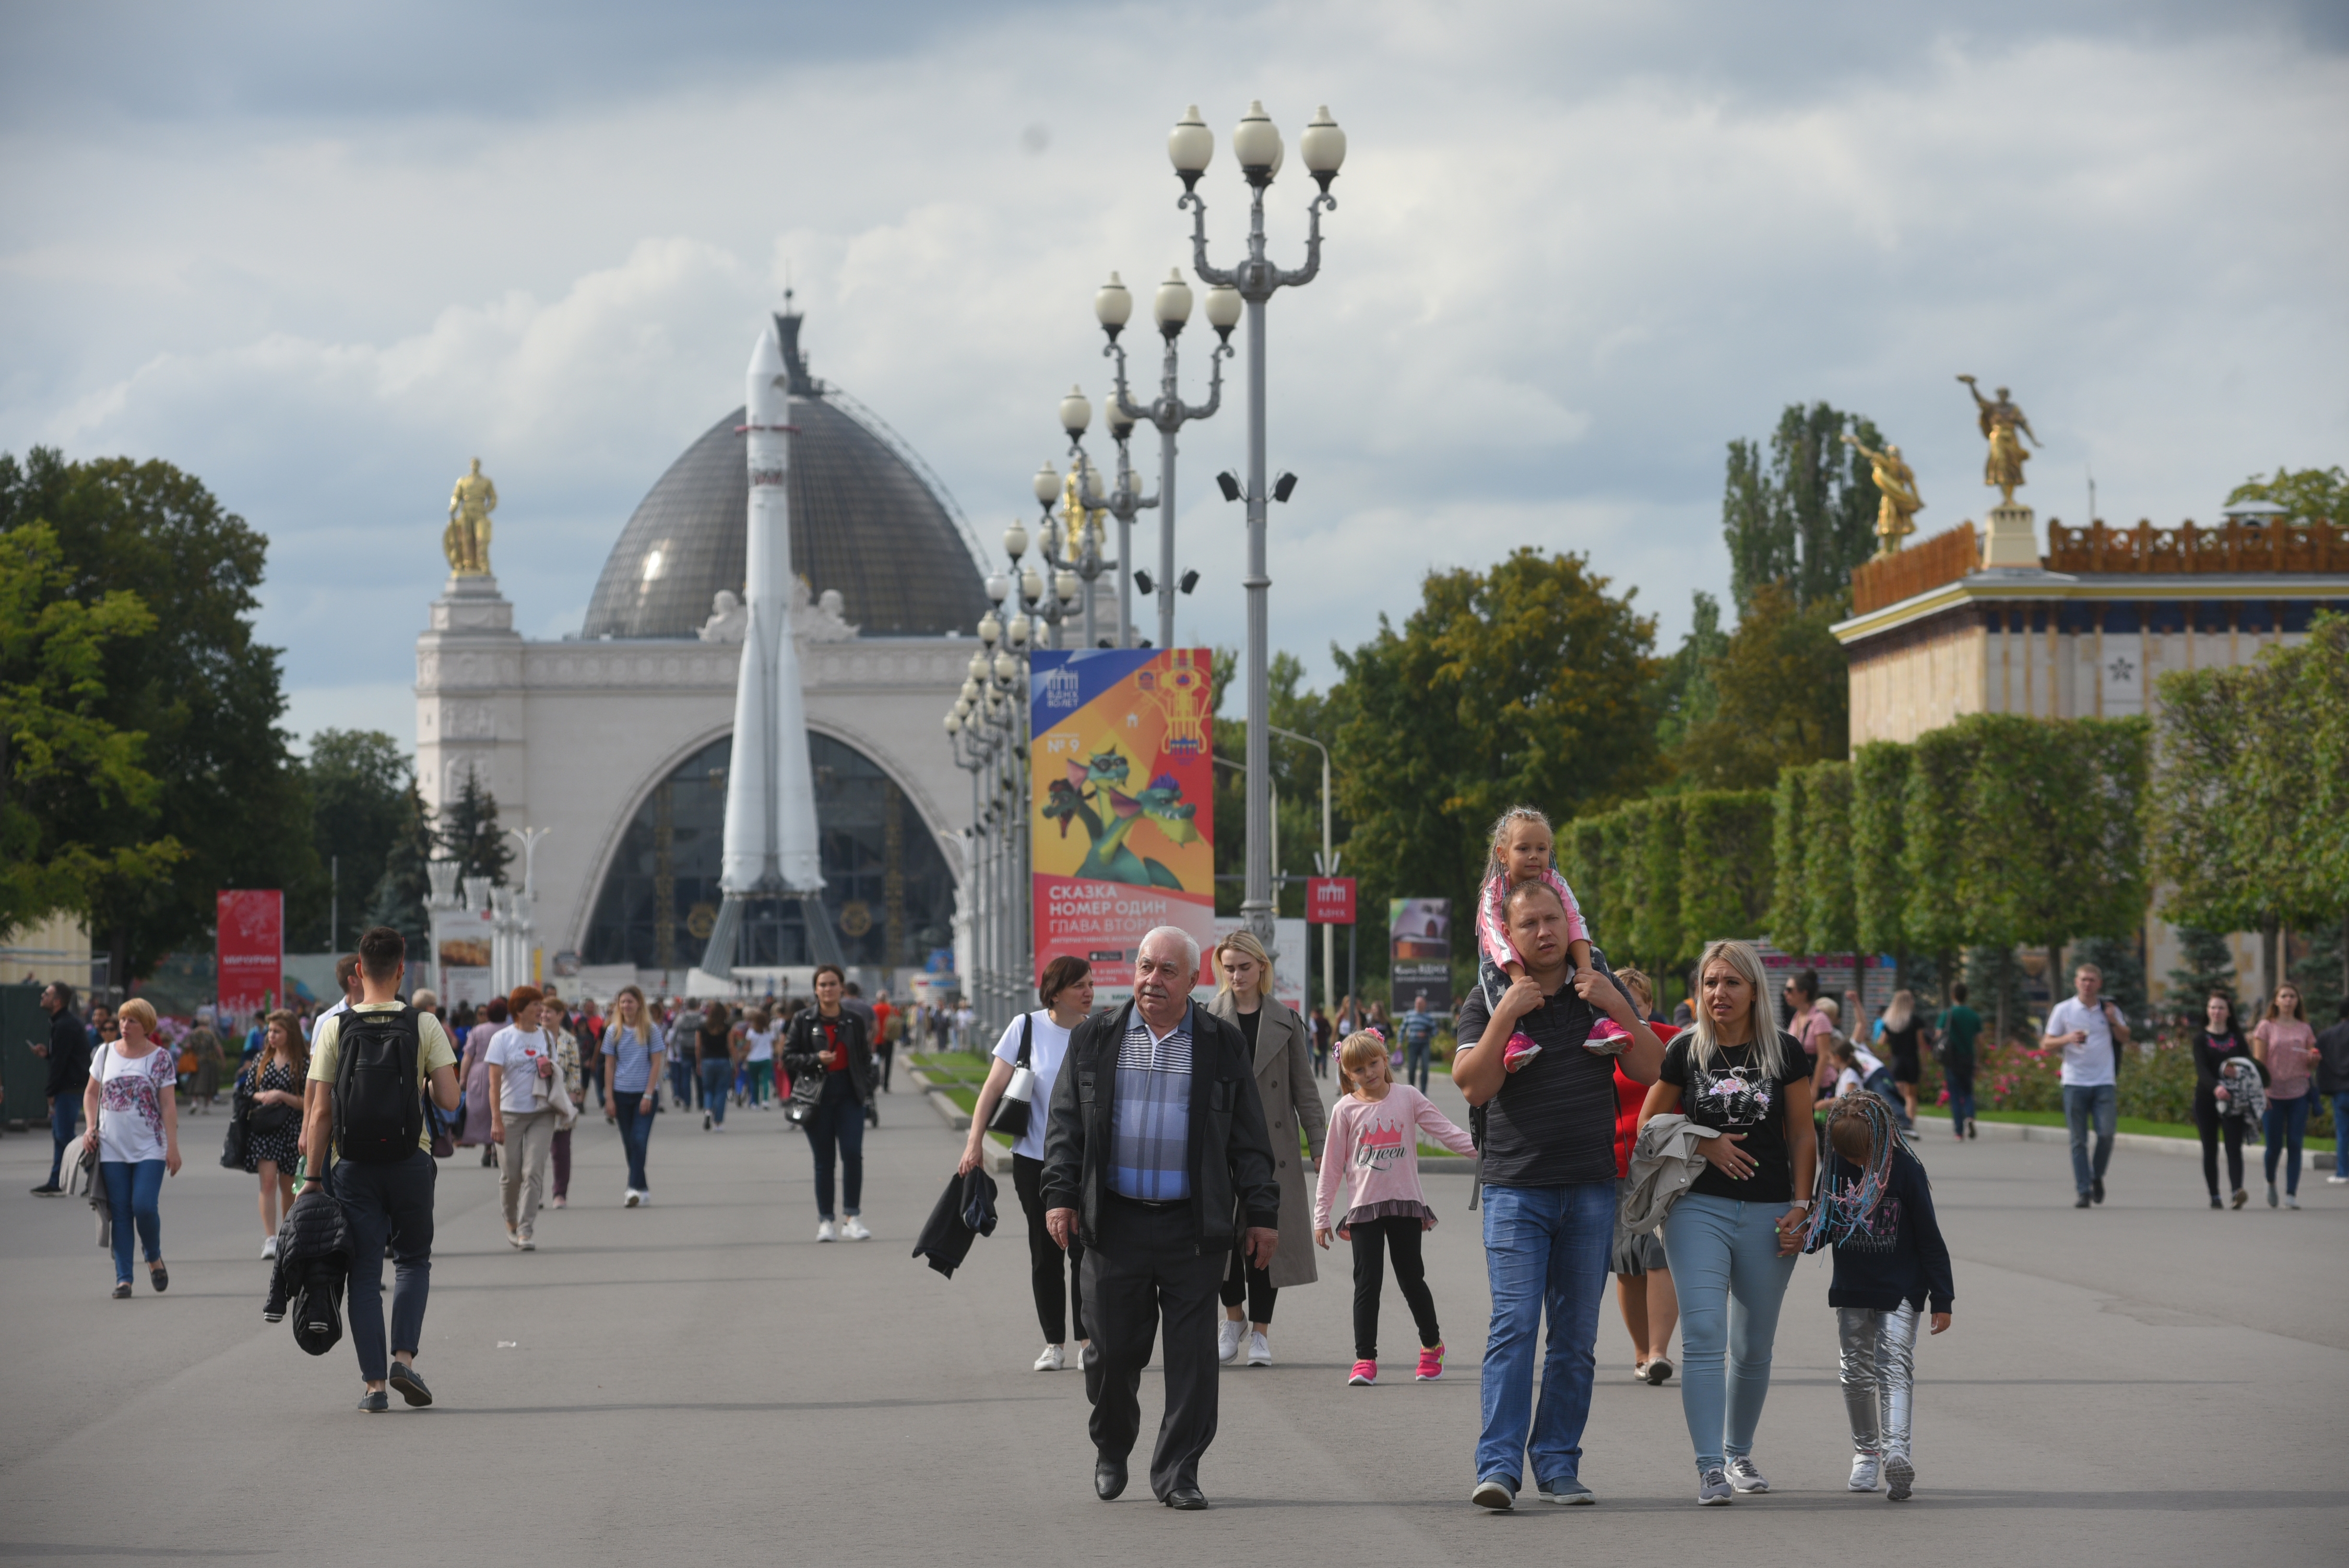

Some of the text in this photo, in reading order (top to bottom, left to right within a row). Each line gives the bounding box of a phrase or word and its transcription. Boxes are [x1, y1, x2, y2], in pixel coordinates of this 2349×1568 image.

[1070, 739, 1080, 753] 9
[1049, 885, 1117, 899] СКАЗКА
[1049, 900, 1167, 917] НОМЕР ОДИН
[1049, 917, 1167, 933] ГЛАВА ВТОРАЯ
[1357, 1144, 1406, 1171] Queen
